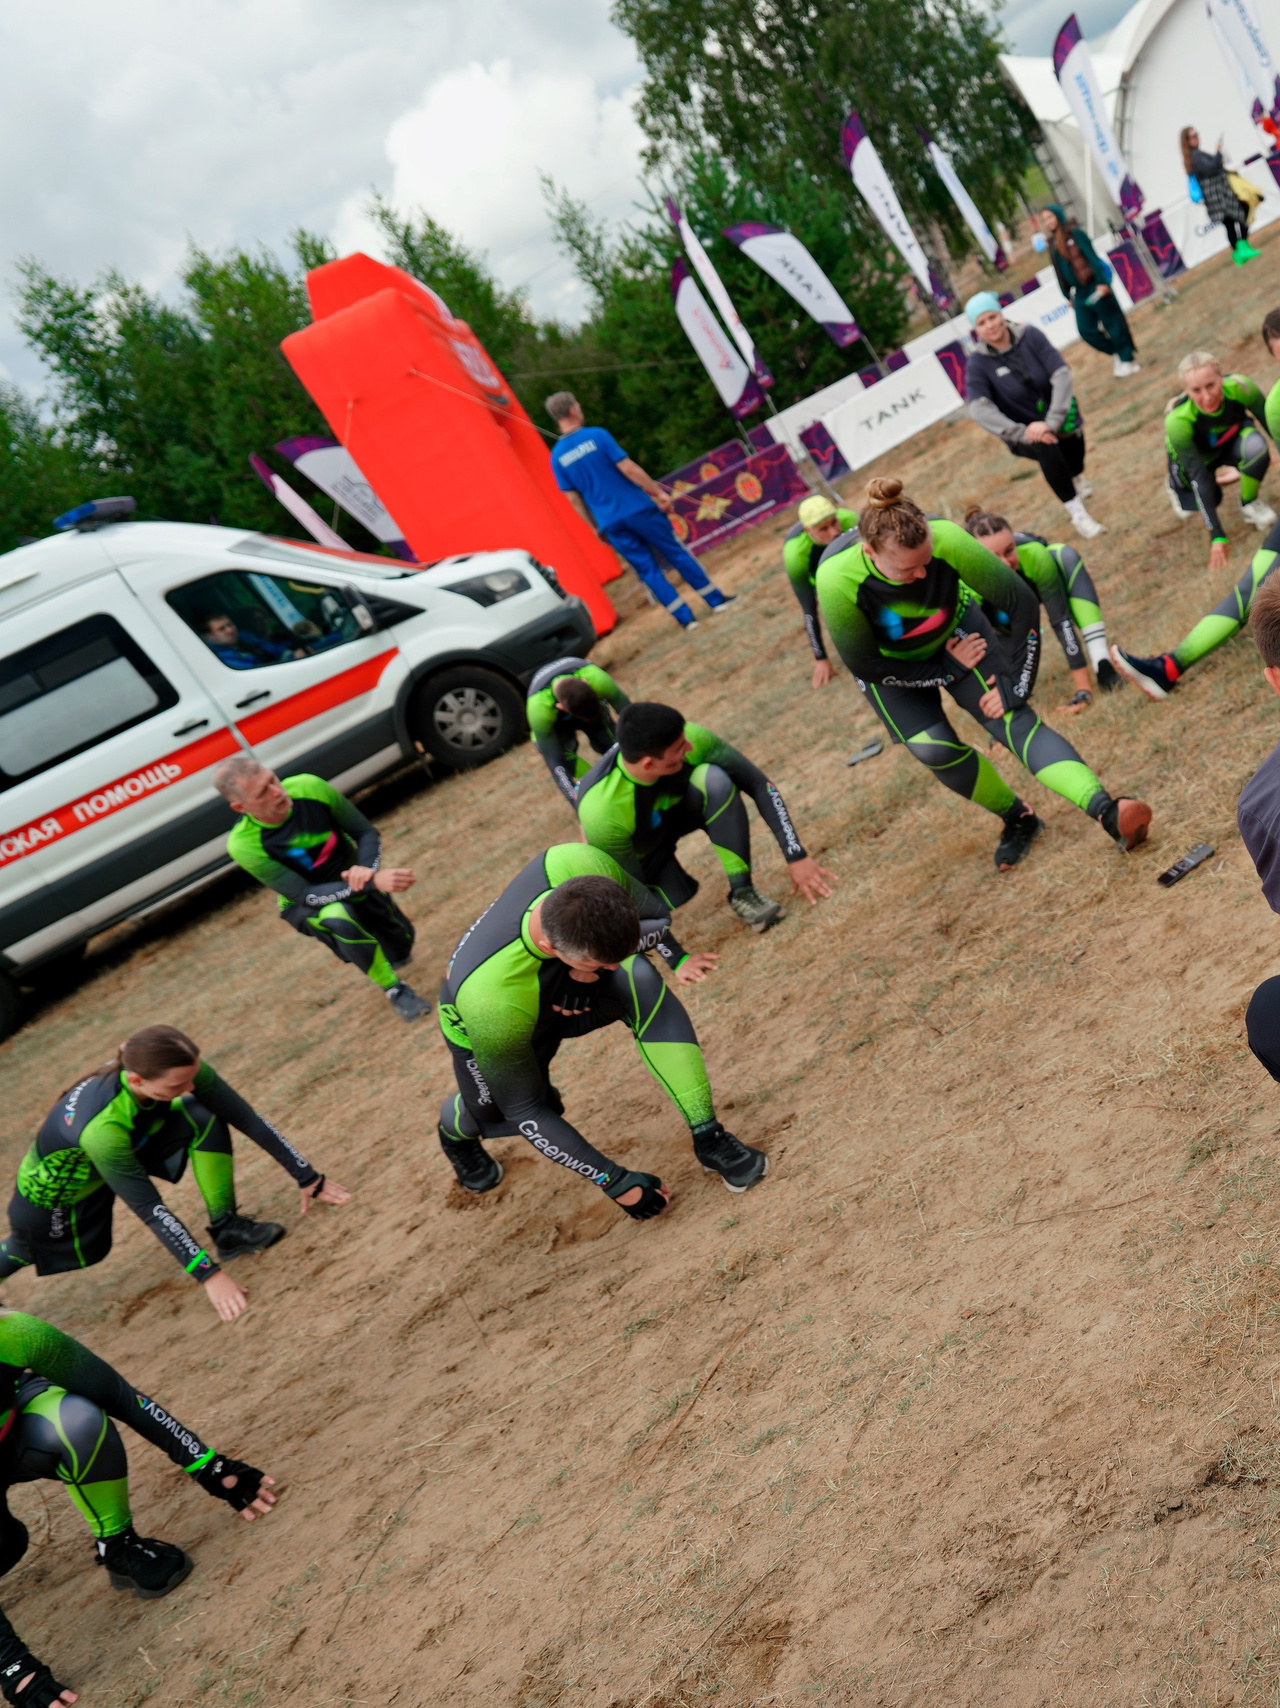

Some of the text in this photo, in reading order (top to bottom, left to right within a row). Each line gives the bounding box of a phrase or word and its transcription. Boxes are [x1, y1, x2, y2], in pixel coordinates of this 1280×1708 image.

[860, 387, 926, 431] TANK
[0, 763, 182, 861] СКАЯ ПОМОЩЬ
[769, 791, 801, 856] Greenway
[465, 1058, 492, 1106] Greenwa
[518, 1119, 604, 1182] Greenway
[153, 1204, 200, 1256] Greenwa
